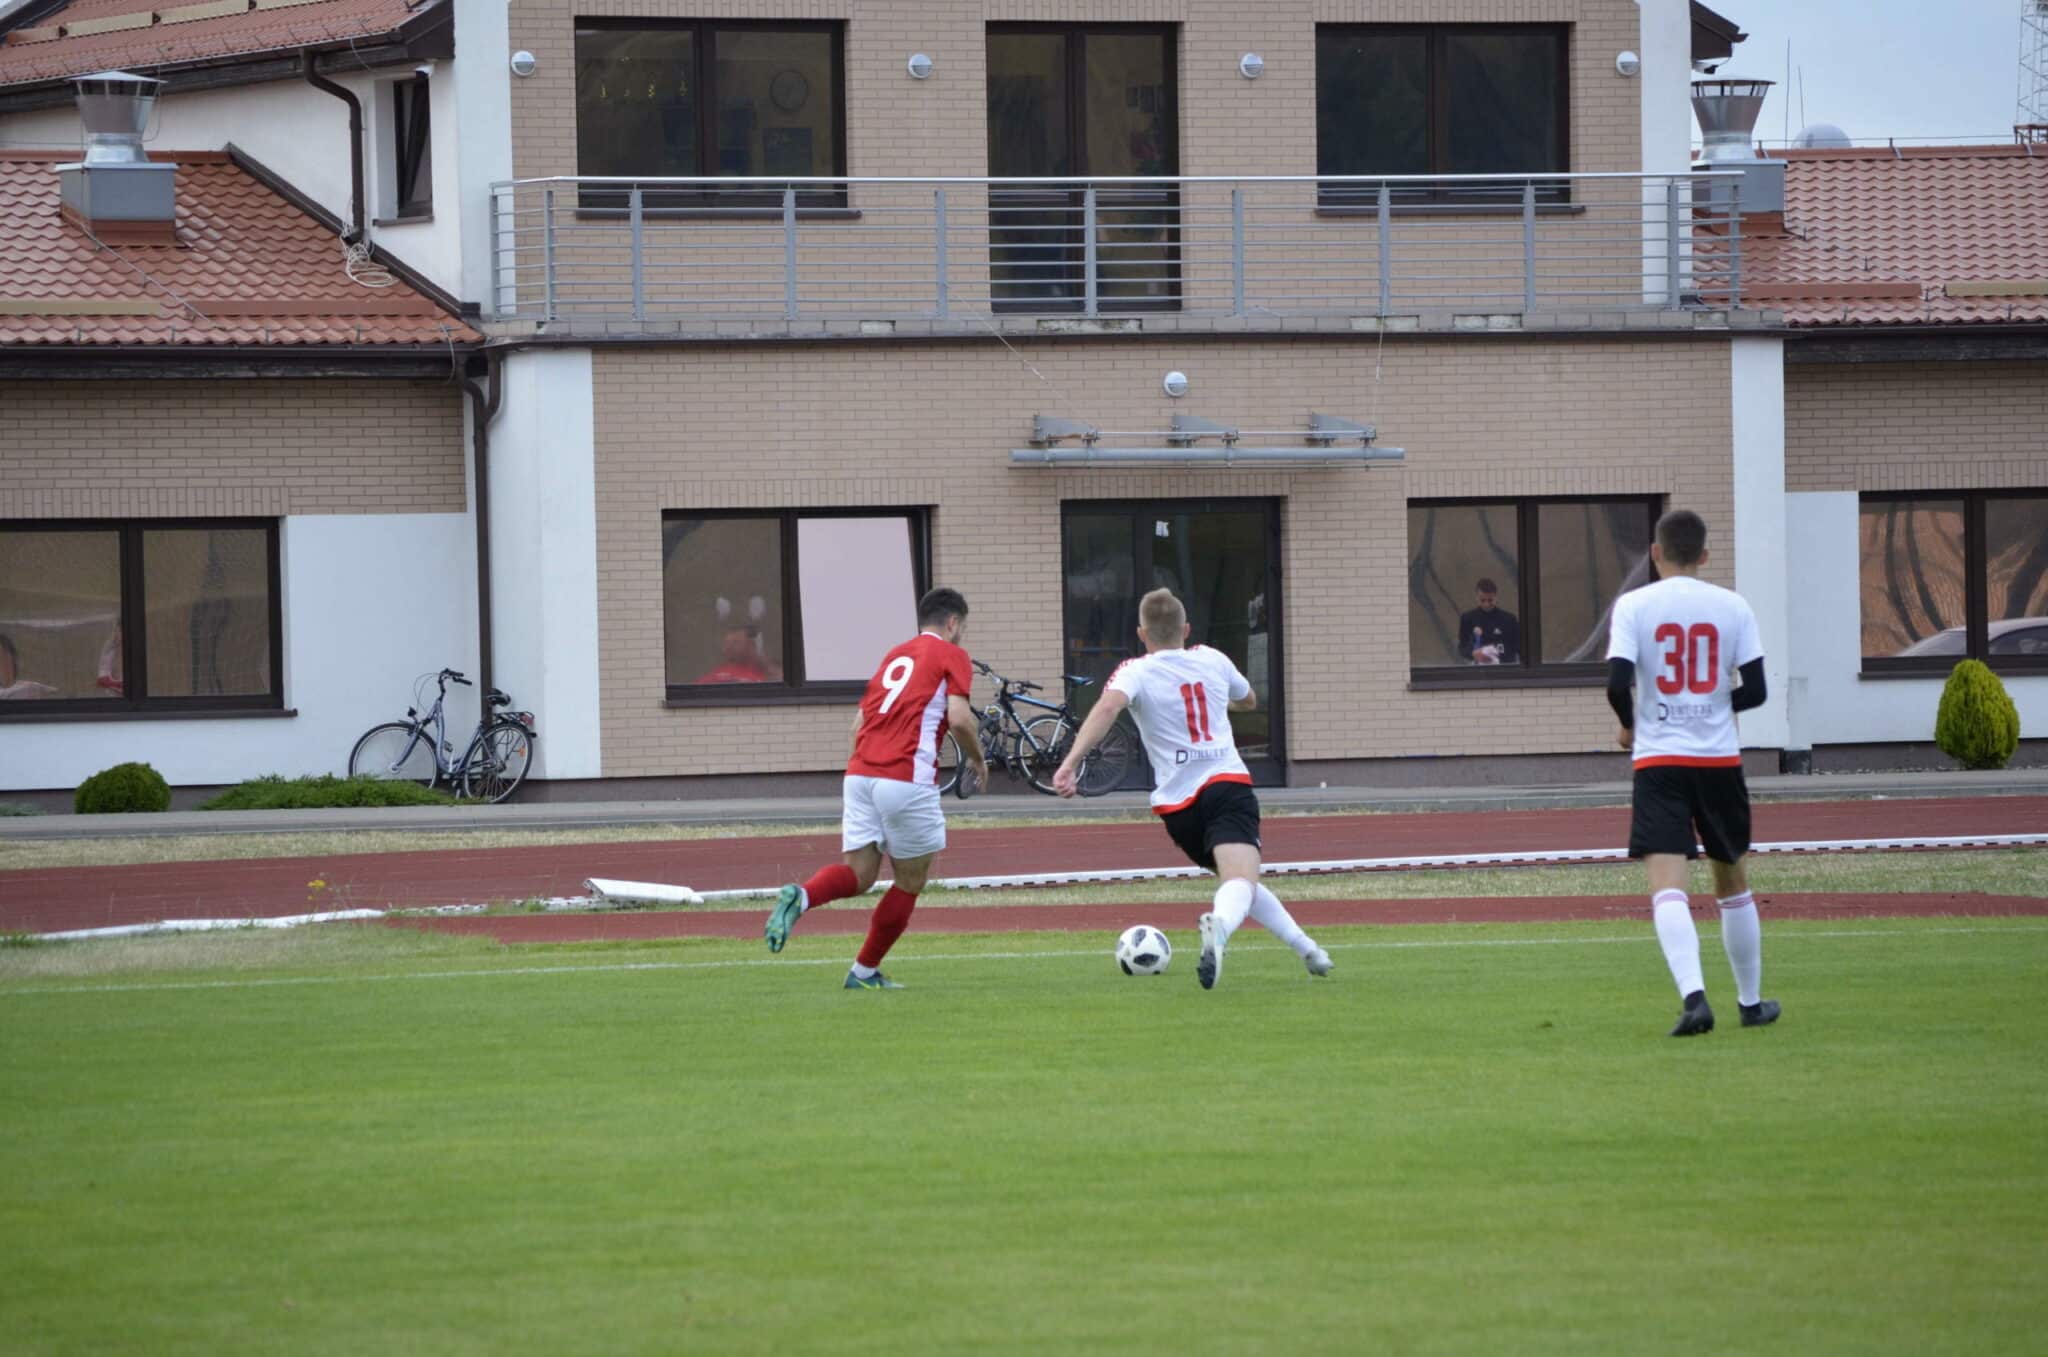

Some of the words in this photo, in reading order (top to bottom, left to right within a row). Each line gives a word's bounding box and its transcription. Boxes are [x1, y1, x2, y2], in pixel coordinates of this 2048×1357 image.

[879, 656, 914, 714] 9
[1655, 623, 1719, 694] 30
[1180, 681, 1213, 743] 11
